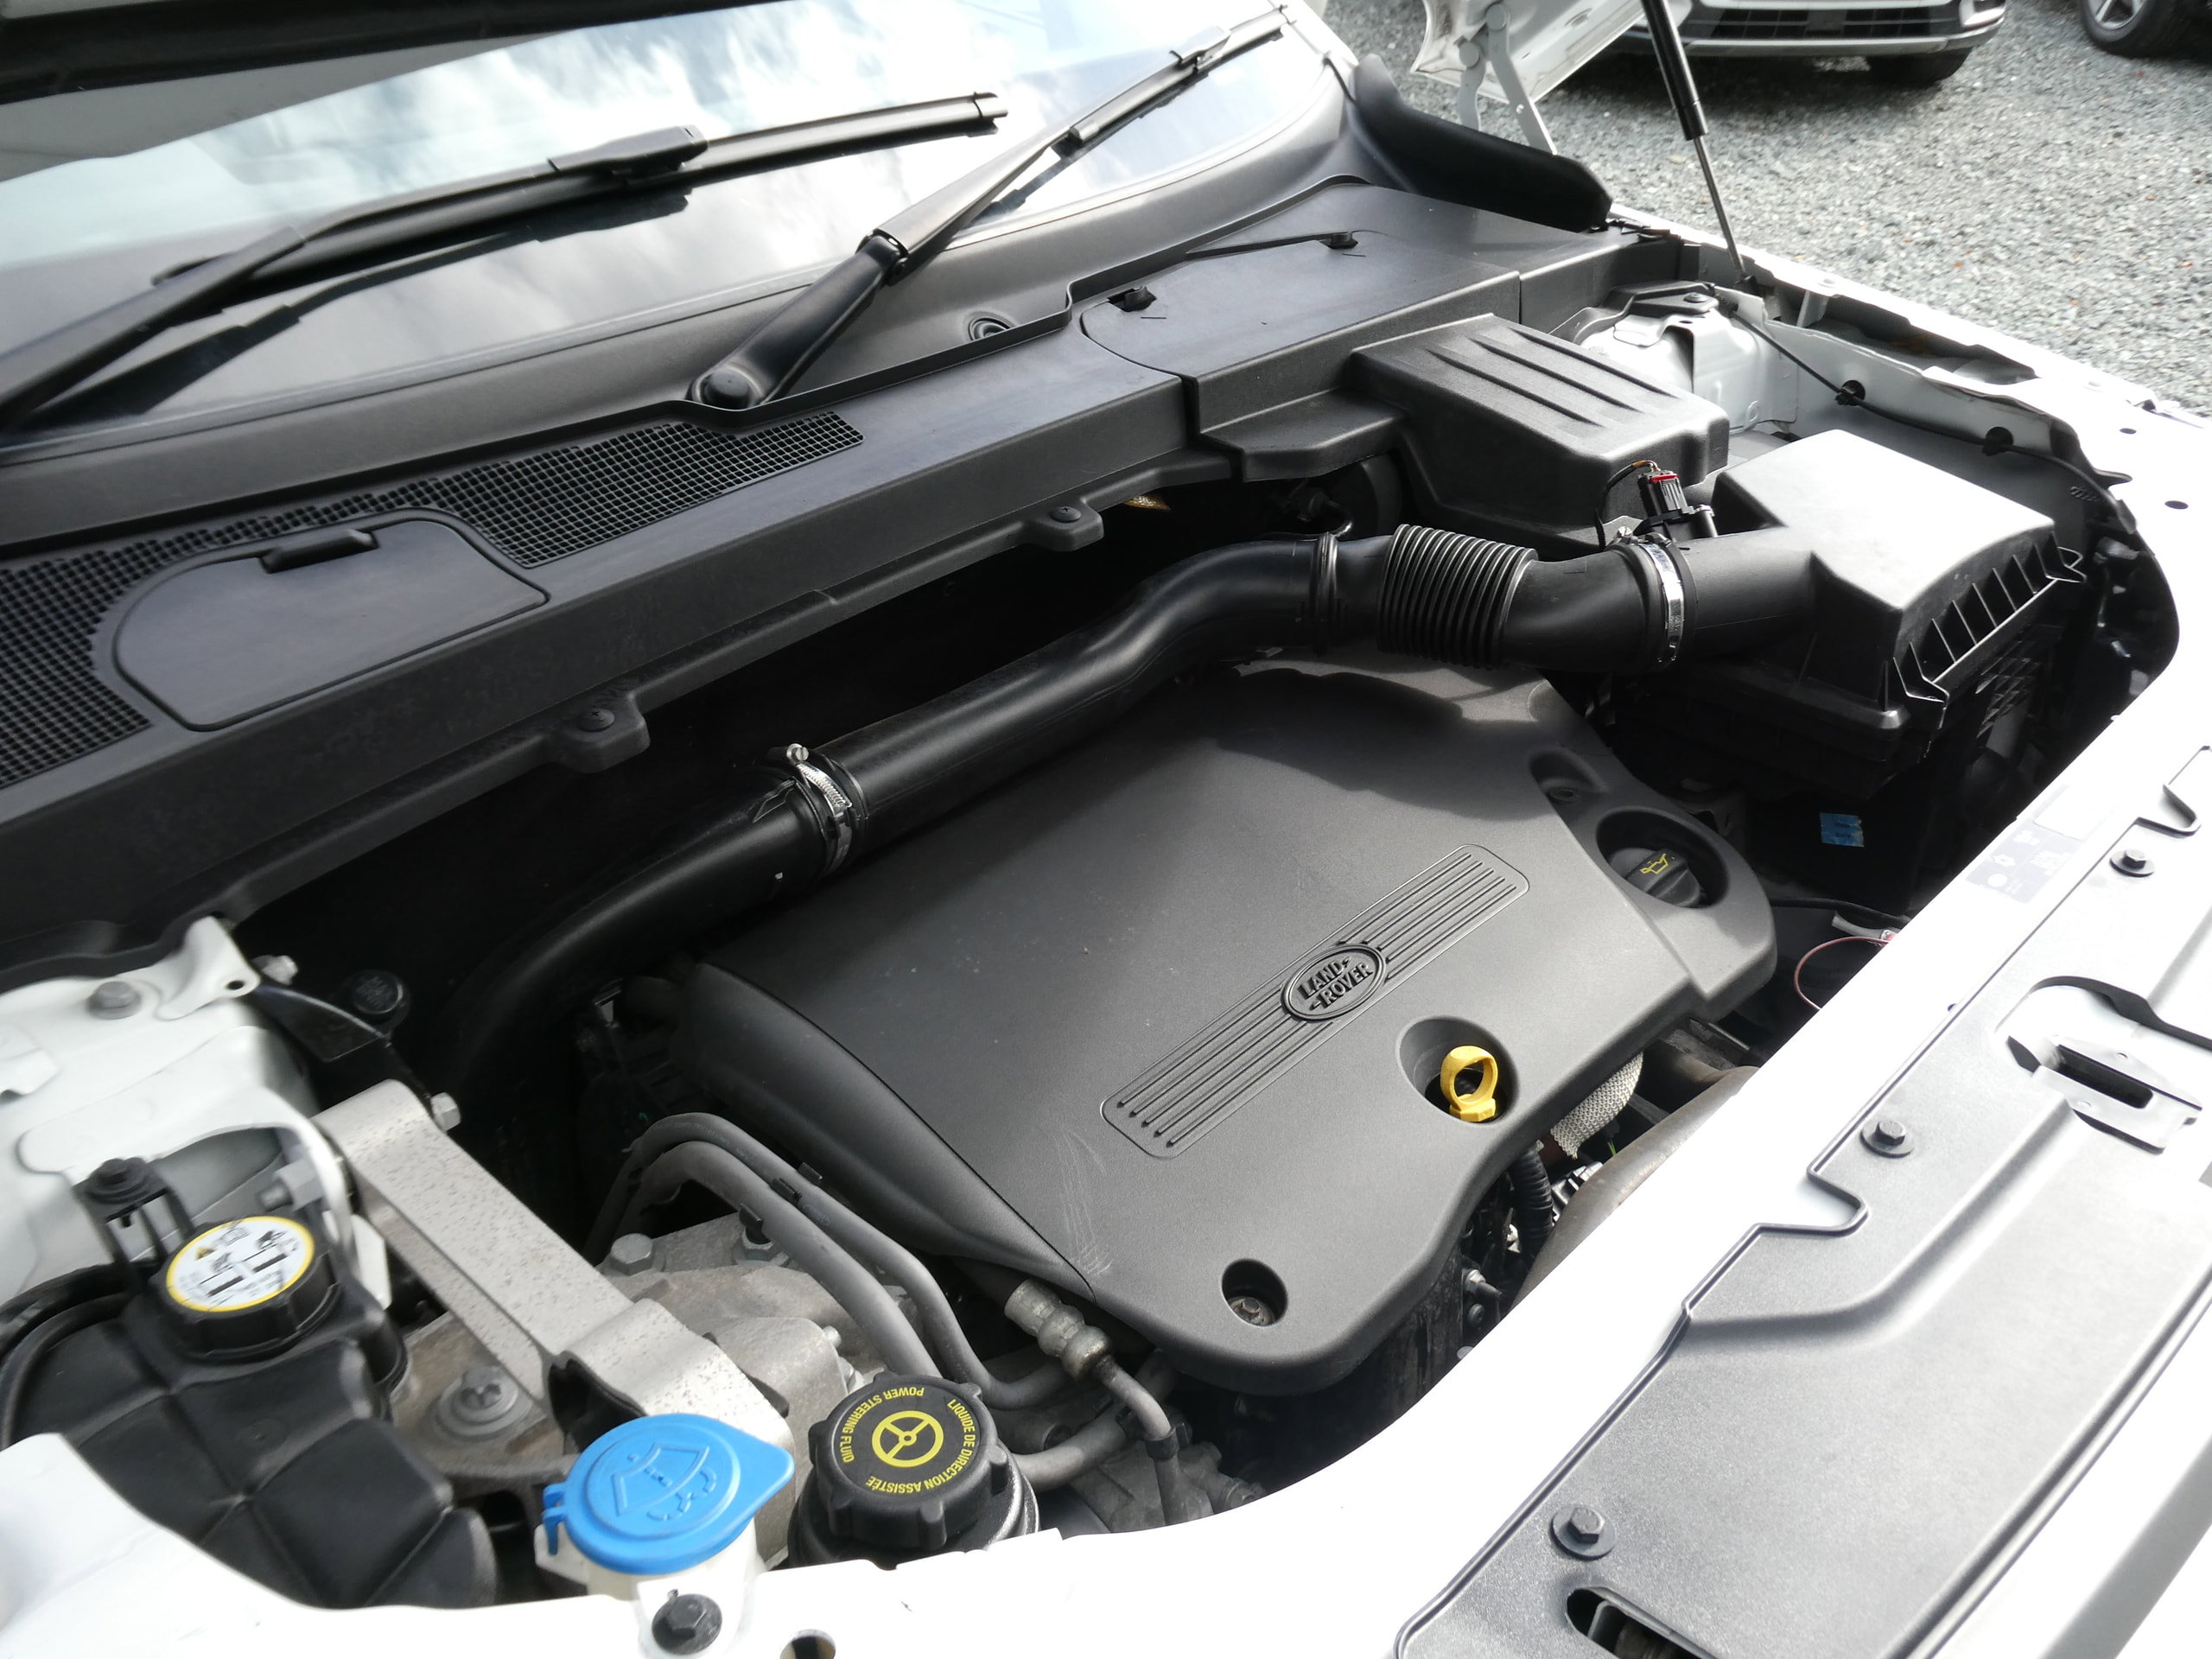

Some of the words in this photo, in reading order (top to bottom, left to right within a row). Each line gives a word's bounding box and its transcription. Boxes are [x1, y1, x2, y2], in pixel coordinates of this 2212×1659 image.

[1297, 960, 1346, 1000] LAND
[1315, 963, 1374, 1009] ROVER
[883, 1387, 925, 1400] POWER
[842, 1395, 882, 1433] STEERING
[947, 1399, 976, 1433] LIQUIDE
[840, 1436, 855, 1463] FLUID
[963, 1434, 976, 1447] DE
[866, 1476, 922, 1493] ASSISTÉE
[924, 1448, 973, 1490] DIRECTION
